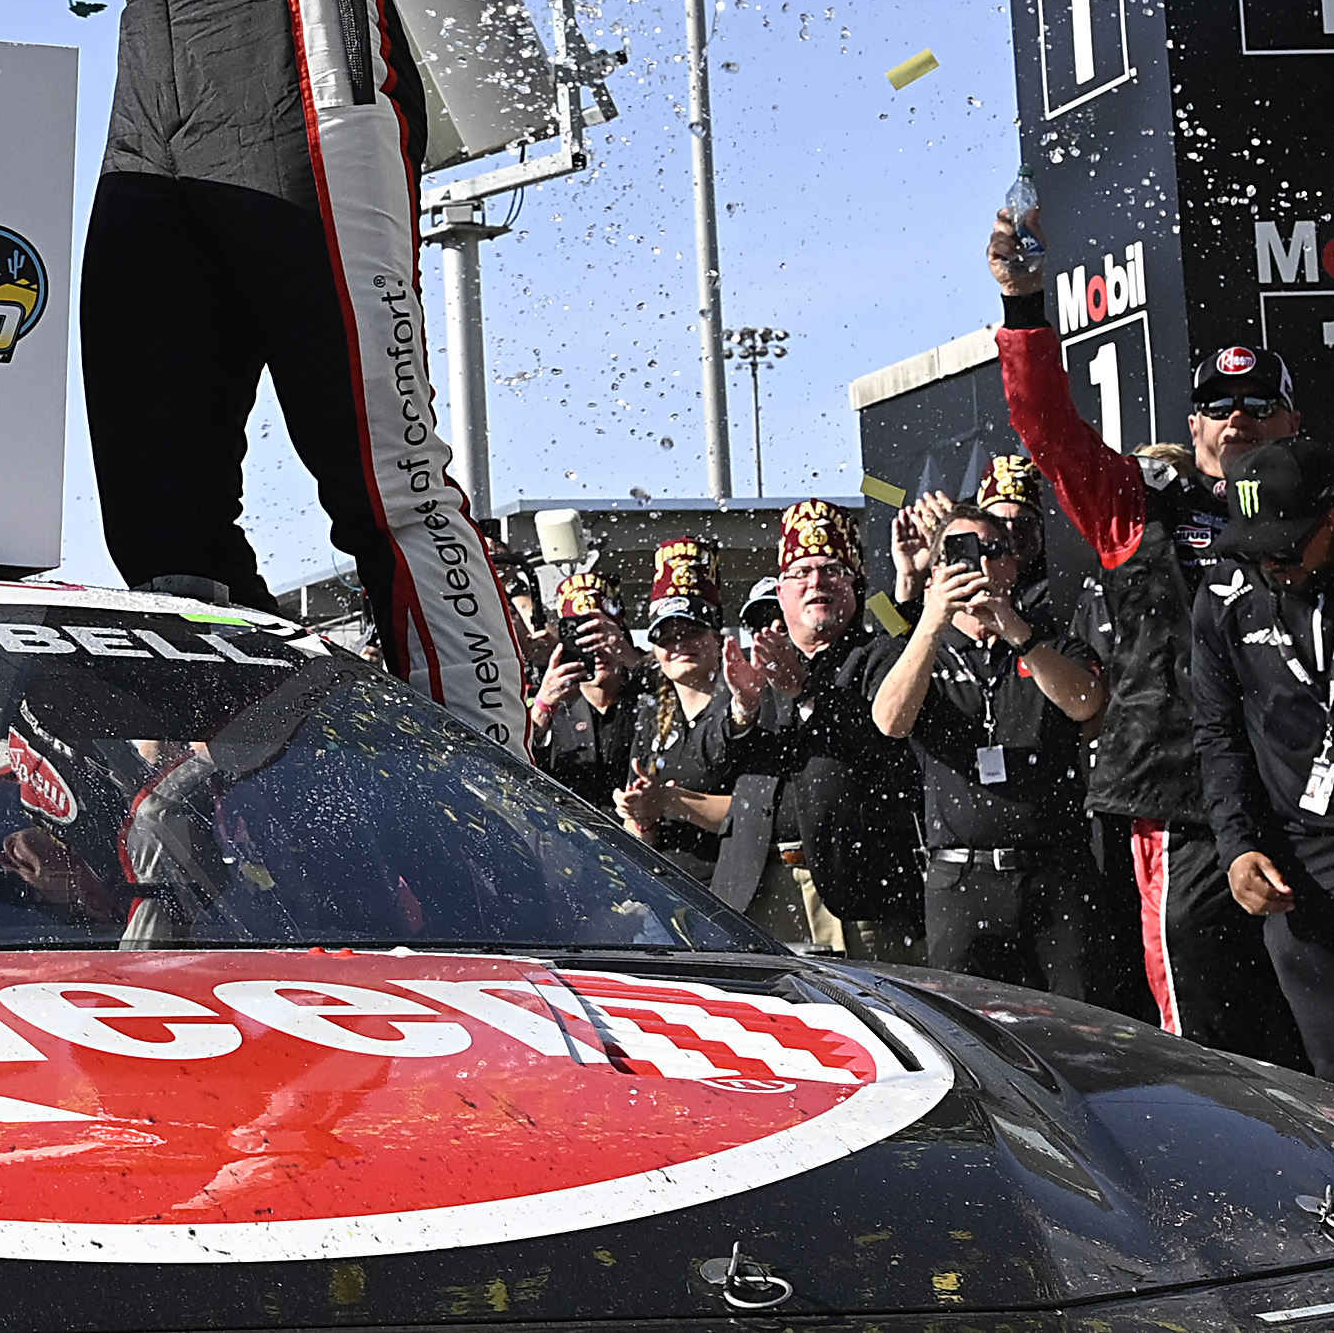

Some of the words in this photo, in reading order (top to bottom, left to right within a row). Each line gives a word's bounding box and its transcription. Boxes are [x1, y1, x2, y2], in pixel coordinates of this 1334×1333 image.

[1057, 241, 1147, 336] Mobil
[381, 278, 428, 446] comfort.
[1089, 342, 1122, 455] 1
[398, 459, 430, 494] of
[415, 498, 479, 617] degree
[473, 632, 504, 710] new
